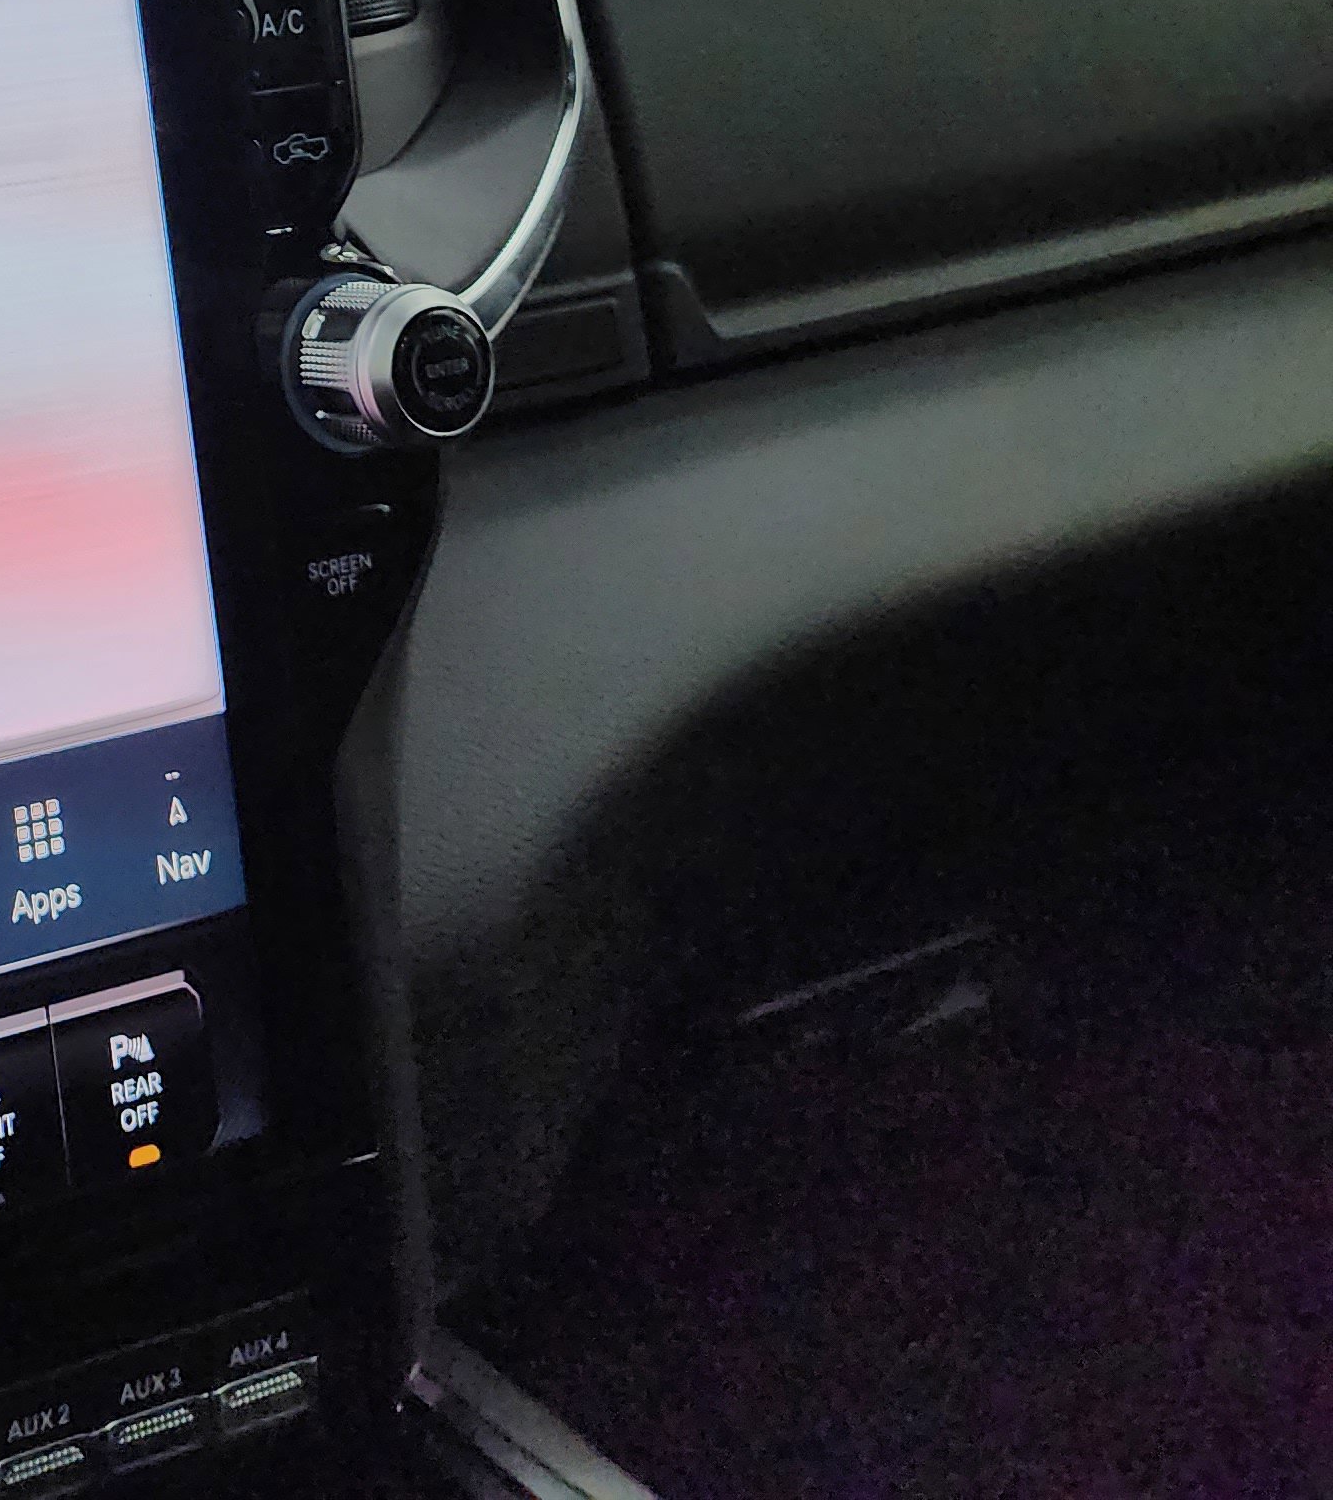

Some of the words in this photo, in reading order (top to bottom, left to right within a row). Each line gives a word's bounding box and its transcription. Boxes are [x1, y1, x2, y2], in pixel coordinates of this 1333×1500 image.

[261, 8, 305, 38] A/C
[307, 552, 373, 582] SCREEN
[326, 575, 359, 597] OFF
[155, 849, 212, 886] Nav
[10, 881, 83, 926] Apps
[109, 1071, 163, 1106] REAR
[119, 1101, 160, 1133] OFF
